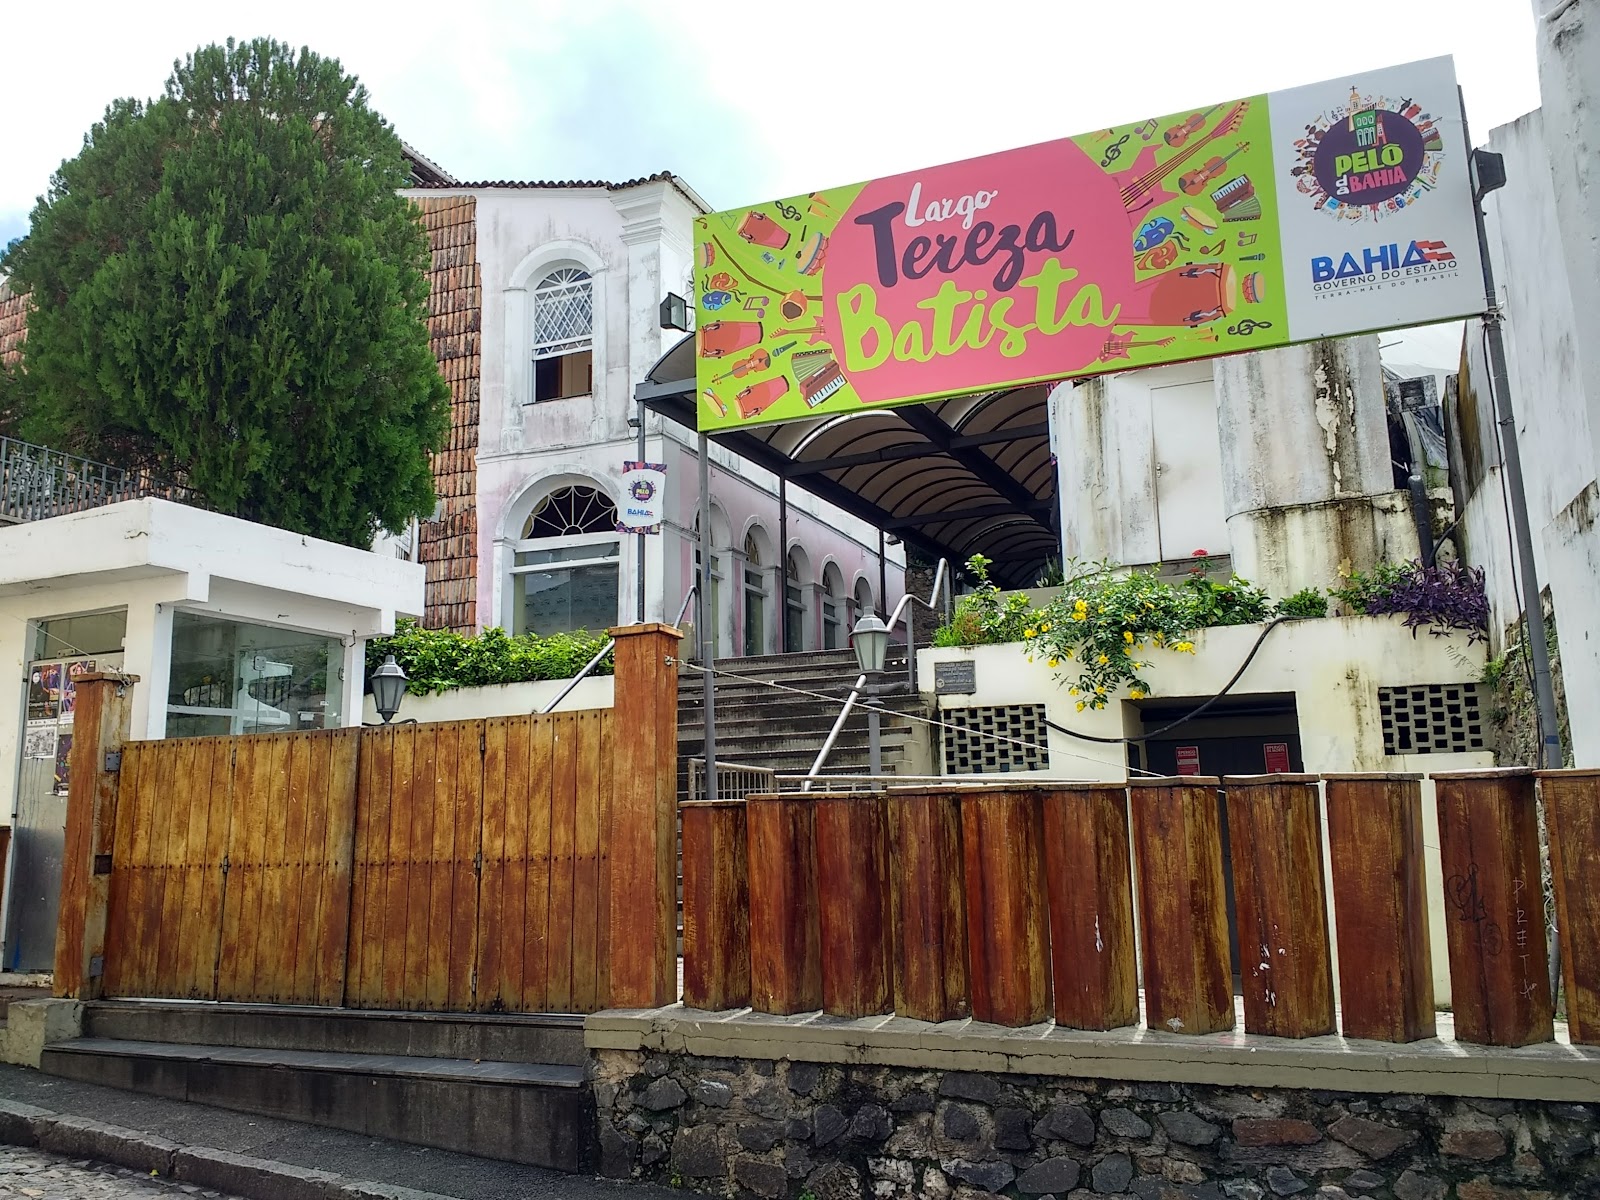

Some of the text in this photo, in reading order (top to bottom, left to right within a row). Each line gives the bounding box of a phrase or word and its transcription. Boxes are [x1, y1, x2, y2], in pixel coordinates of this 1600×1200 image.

[1335, 143, 1403, 177] PELÔ
[1349, 165, 1407, 193] BAHIA
[903, 181, 1000, 230] Largo
[854, 200, 1075, 292] Tereza
[1311, 239, 1431, 283] BAHIA
[1313, 260, 1457, 292] GOVERNO DO ESTADO
[1391, 280, 1406, 288] DO
[1415, 272, 1459, 284] BRASIL
[837, 257, 1122, 373] Batista
